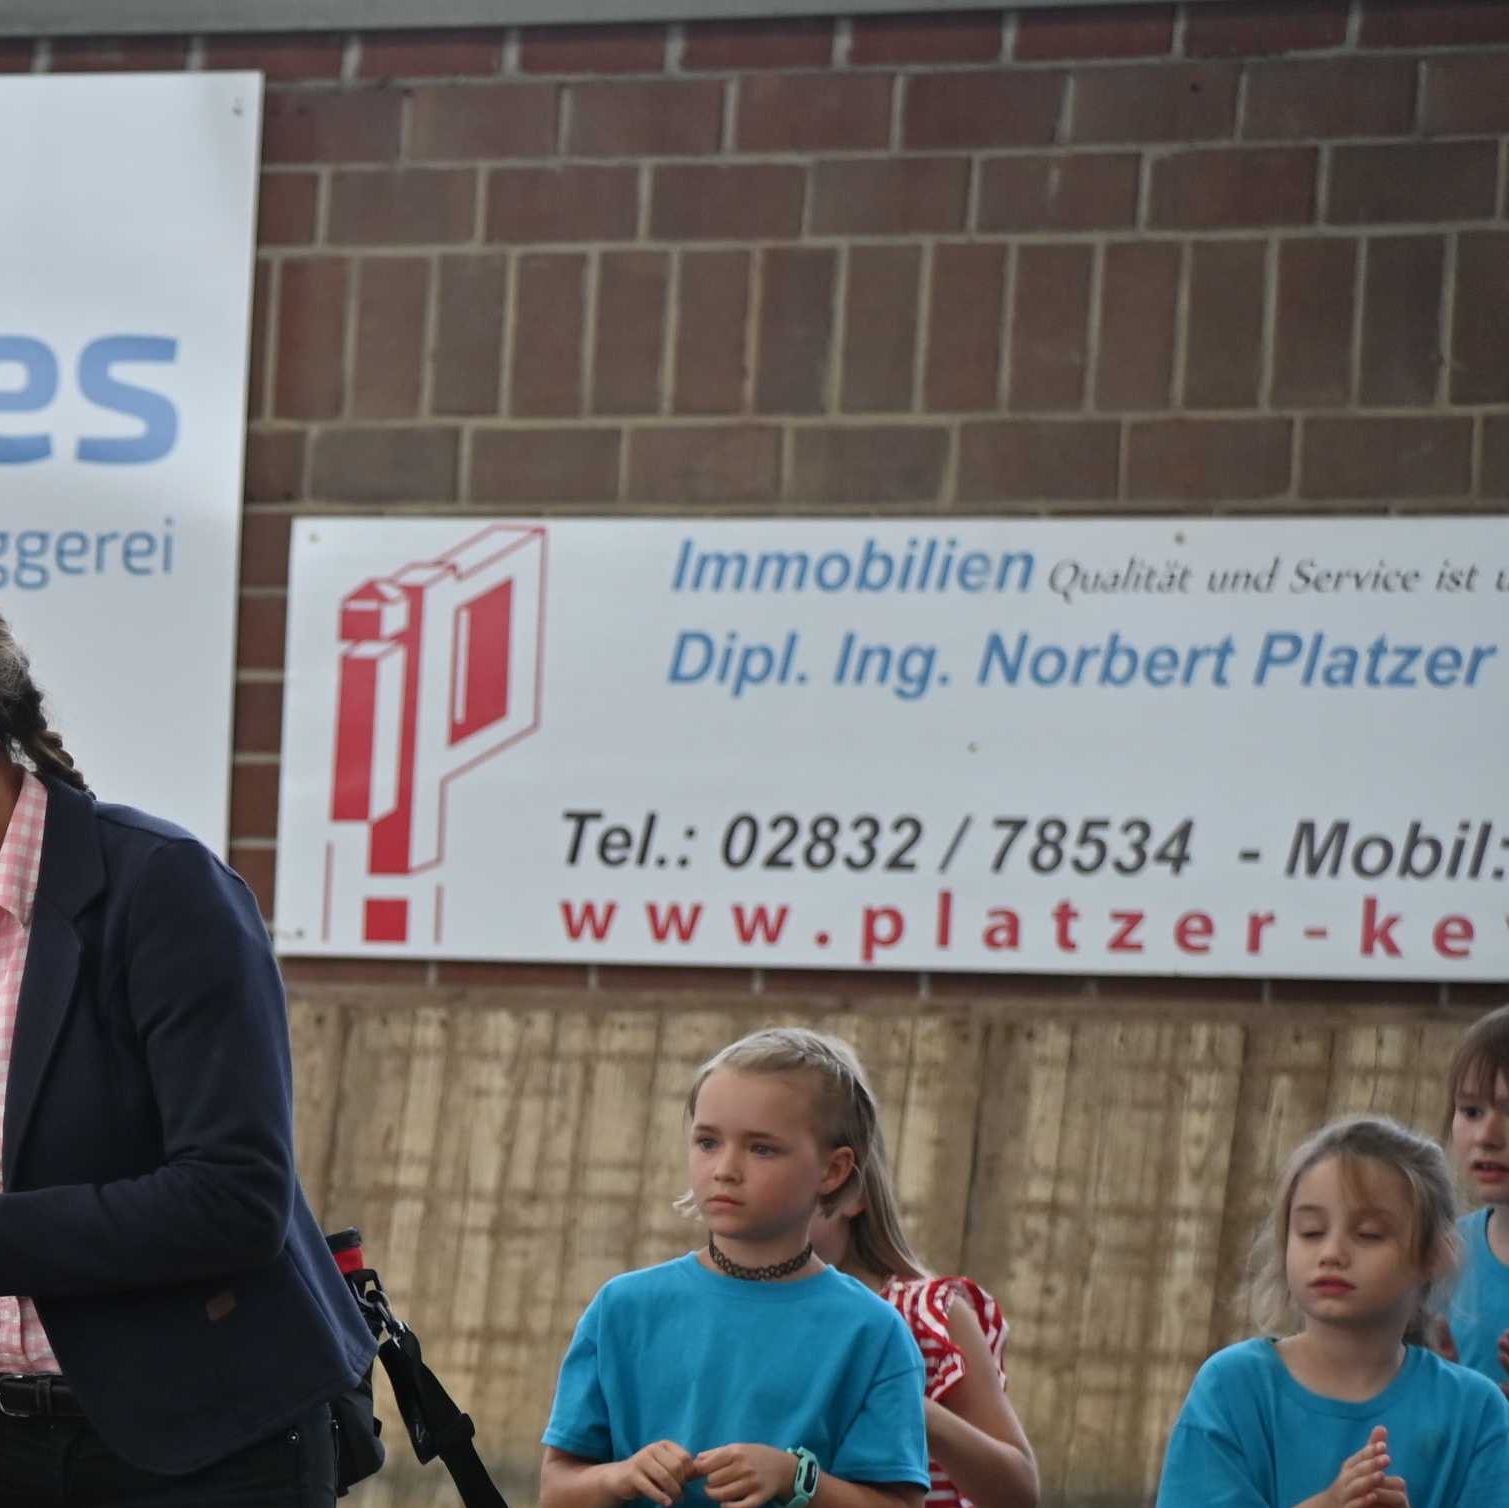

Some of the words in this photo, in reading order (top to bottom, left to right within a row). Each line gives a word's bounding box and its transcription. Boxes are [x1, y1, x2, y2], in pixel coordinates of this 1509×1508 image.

[671, 537, 1036, 595] Immobilien
[1048, 557, 1192, 606] Qualität
[1207, 557, 1278, 594] und
[1289, 559, 1422, 595] Service
[1435, 558, 1479, 593] ist
[666, 630, 809, 696] Dipl.
[833, 633, 949, 700] Ing.
[976, 631, 1235, 689] Norbert
[1252, 631, 1497, 689] Platzer
[562, 810, 697, 868] Tel.:
[721, 812, 924, 873] 02832
[990, 817, 1195, 877] 78534
